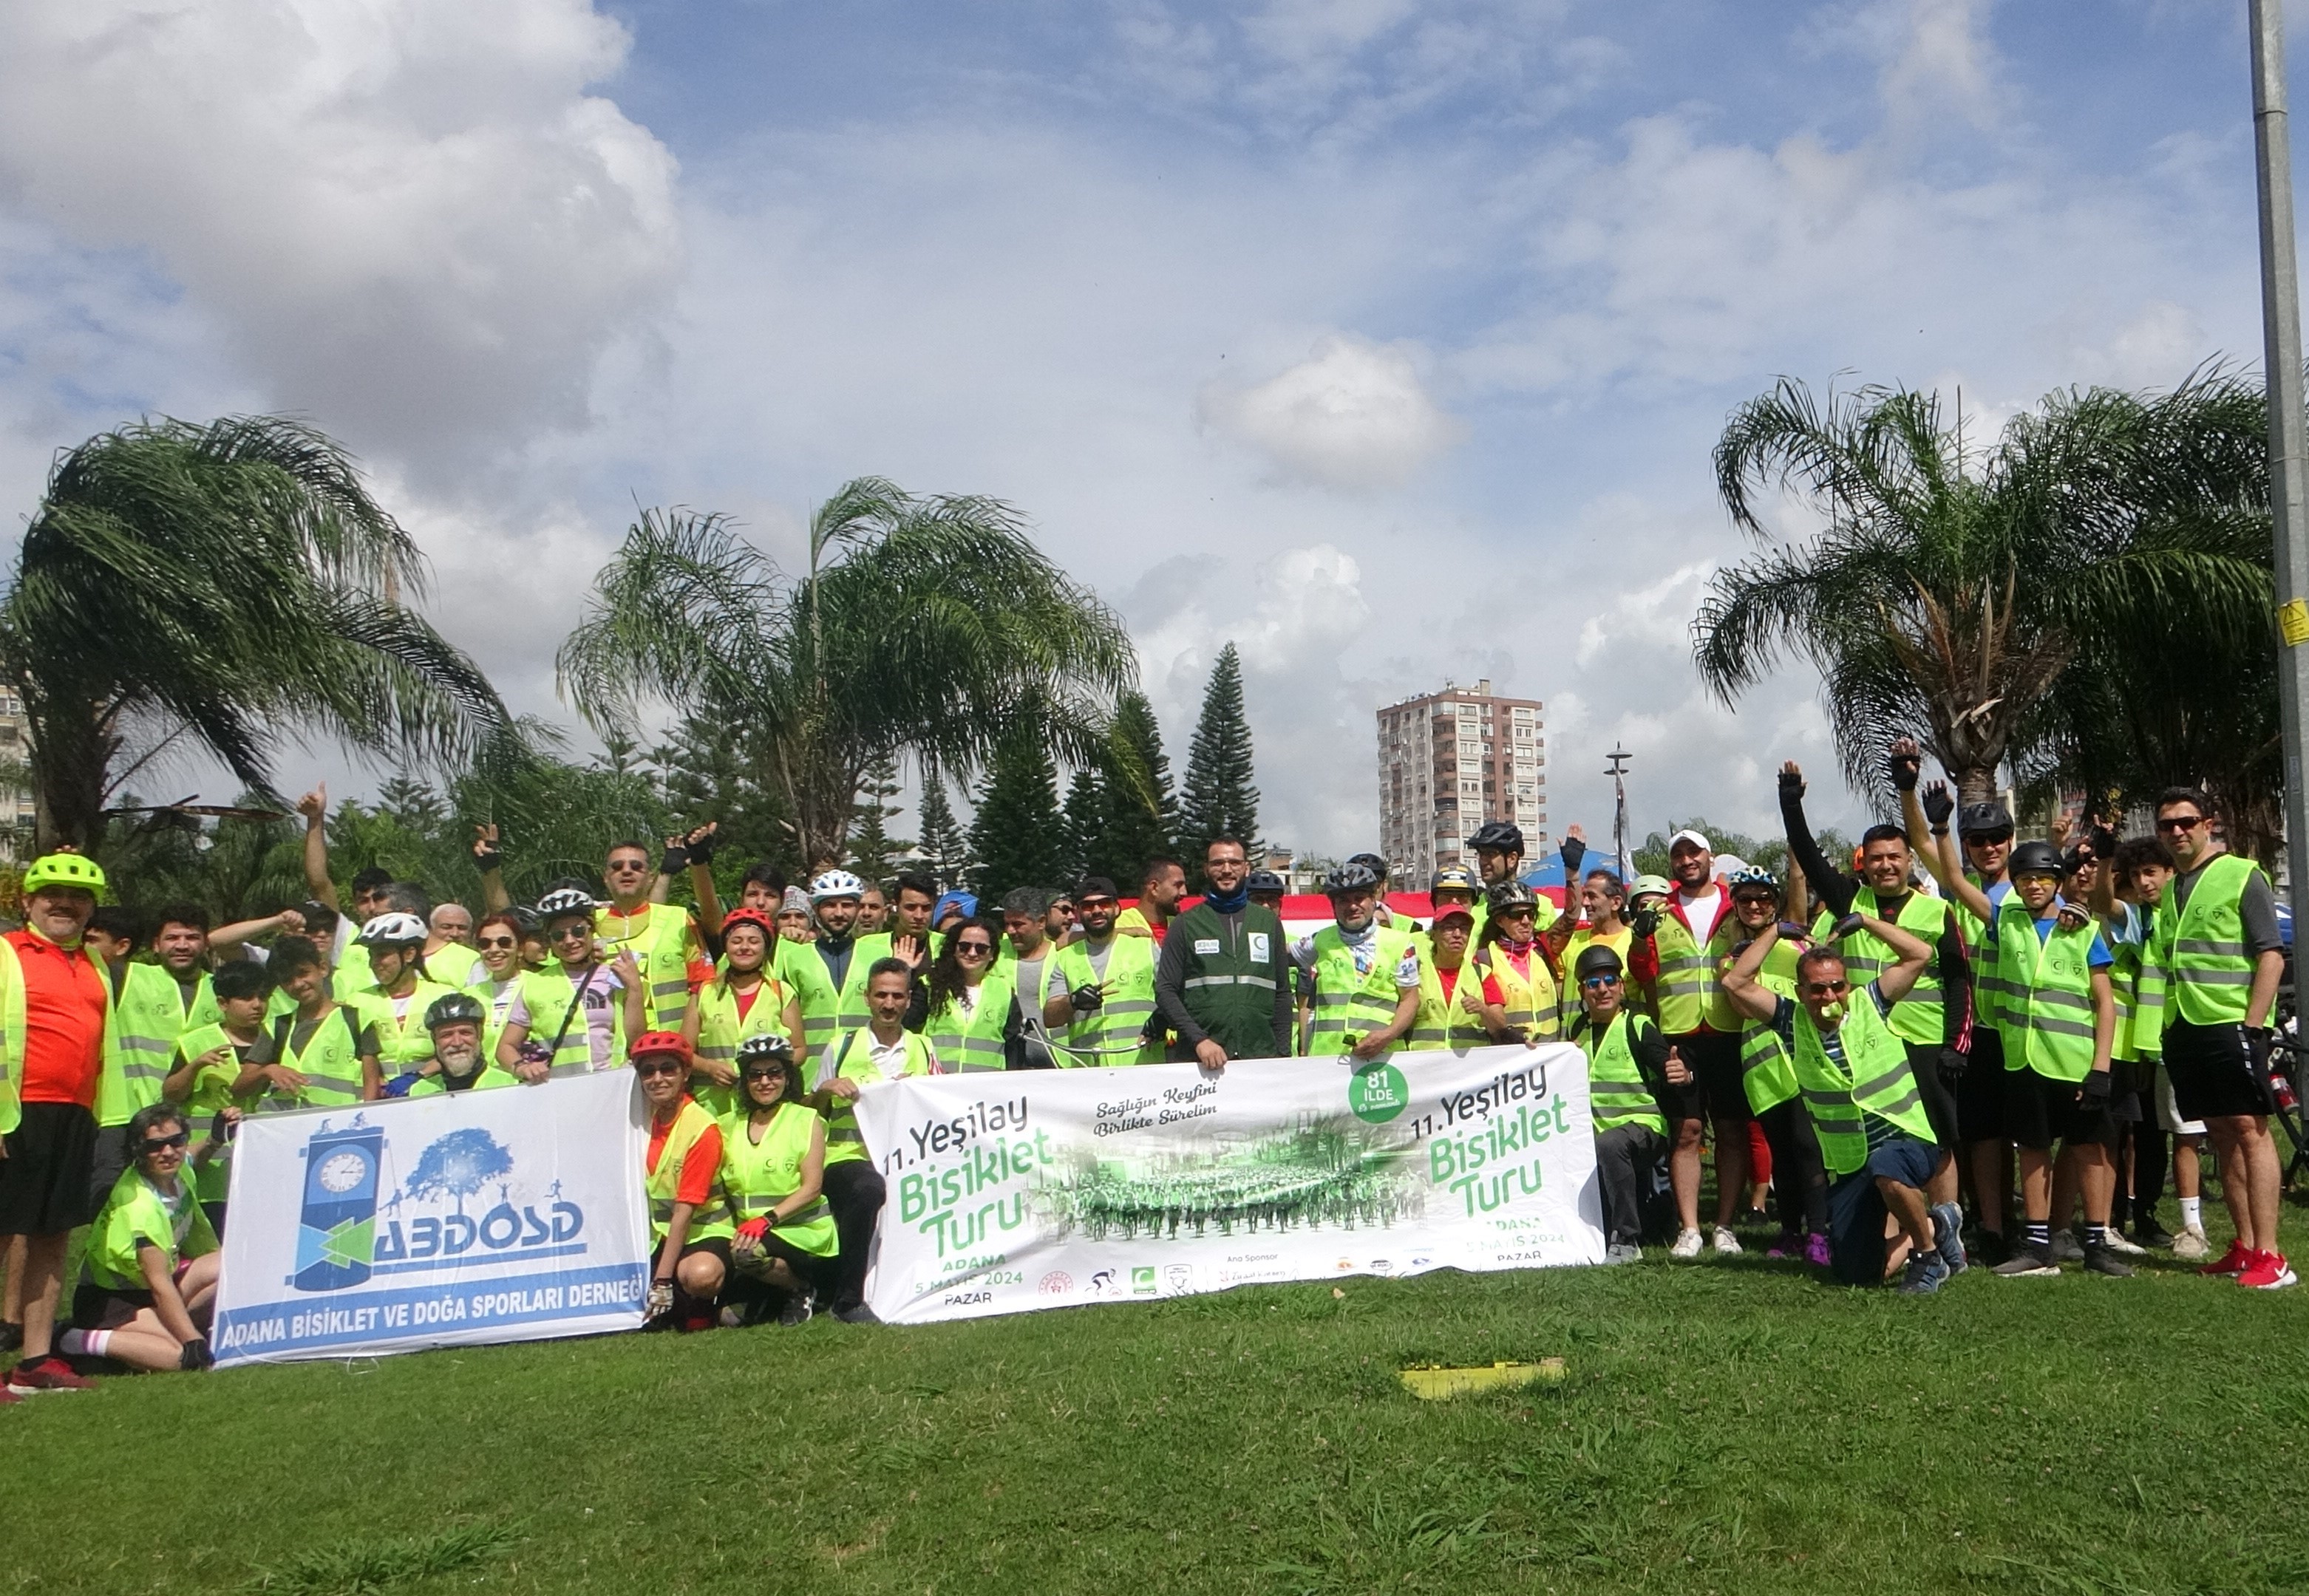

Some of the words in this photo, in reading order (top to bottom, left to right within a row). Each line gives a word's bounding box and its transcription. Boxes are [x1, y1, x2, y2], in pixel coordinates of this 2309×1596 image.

[1364, 1088, 1393, 1102] İLDE
[1367, 1070, 1388, 1088] 81
[1441, 1064, 1547, 1126] Yeşilay
[1096, 1097, 1157, 1119] Sağlığın
[1163, 1081, 1217, 1105] Keyfini
[909, 1095, 1027, 1161] Yeşilay
[1093, 1116, 1154, 1138] Birlikte
[1158, 1104, 1217, 1125] Sürelim
[1429, 1093, 1571, 1184] Bisiklet
[900, 1126, 1053, 1224] Bisiklet
[1449, 1159, 1542, 1218] Turu
[374, 1201, 585, 1262] ABDOSD
[919, 1192, 1023, 1258] Turu
[1530, 1233, 1565, 1245] 2024
[942, 1253, 1006, 1273] ADANA
[1245, 1253, 1279, 1262] Sponsor
[1497, 1250, 1543, 1262] PAZAR
[915, 1282, 923, 1294] 5
[984, 1271, 1023, 1286] 2024
[945, 1292, 992, 1306] PAZAR
[221, 1317, 287, 1349] ADANA
[291, 1306, 379, 1339] BİSİKLET
[383, 1303, 409, 1329] VE
[413, 1295, 467, 1325] DOĞA
[471, 1286, 564, 1318] SPORLARI
